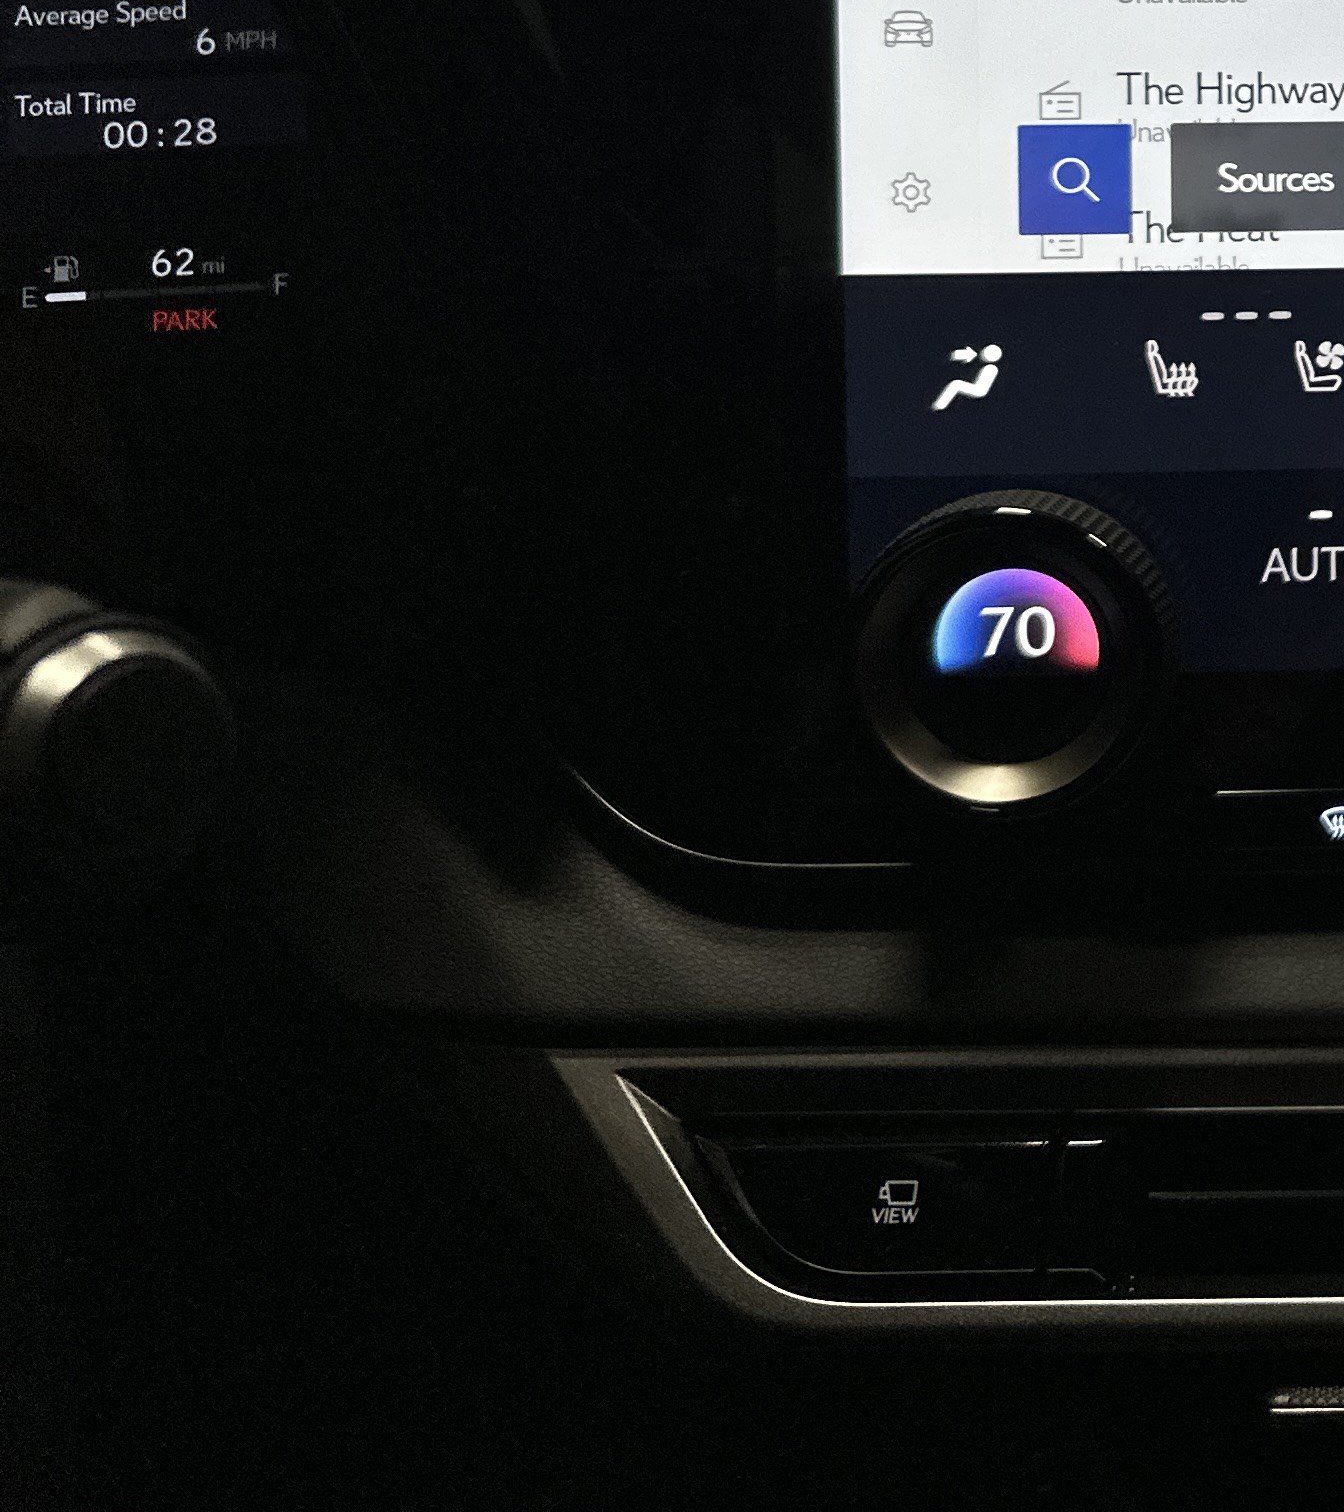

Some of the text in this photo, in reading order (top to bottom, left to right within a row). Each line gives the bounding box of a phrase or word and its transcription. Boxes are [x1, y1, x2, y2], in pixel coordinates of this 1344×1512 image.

[13, 4, 110, 31] Average
[195, 27, 277, 56] 6 MPH
[1115, 71, 1185, 106] The
[14, 91, 137, 118] Total Time
[1217, 162, 1335, 194] Sources
[151, 247, 226, 278] 62 mi
[273, 272, 289, 295] F
[21, 286, 38, 309] E
[152, 308, 218, 332] PARK
[980, 605, 1056, 657] 70
[872, 1207, 919, 1224] VIEW
